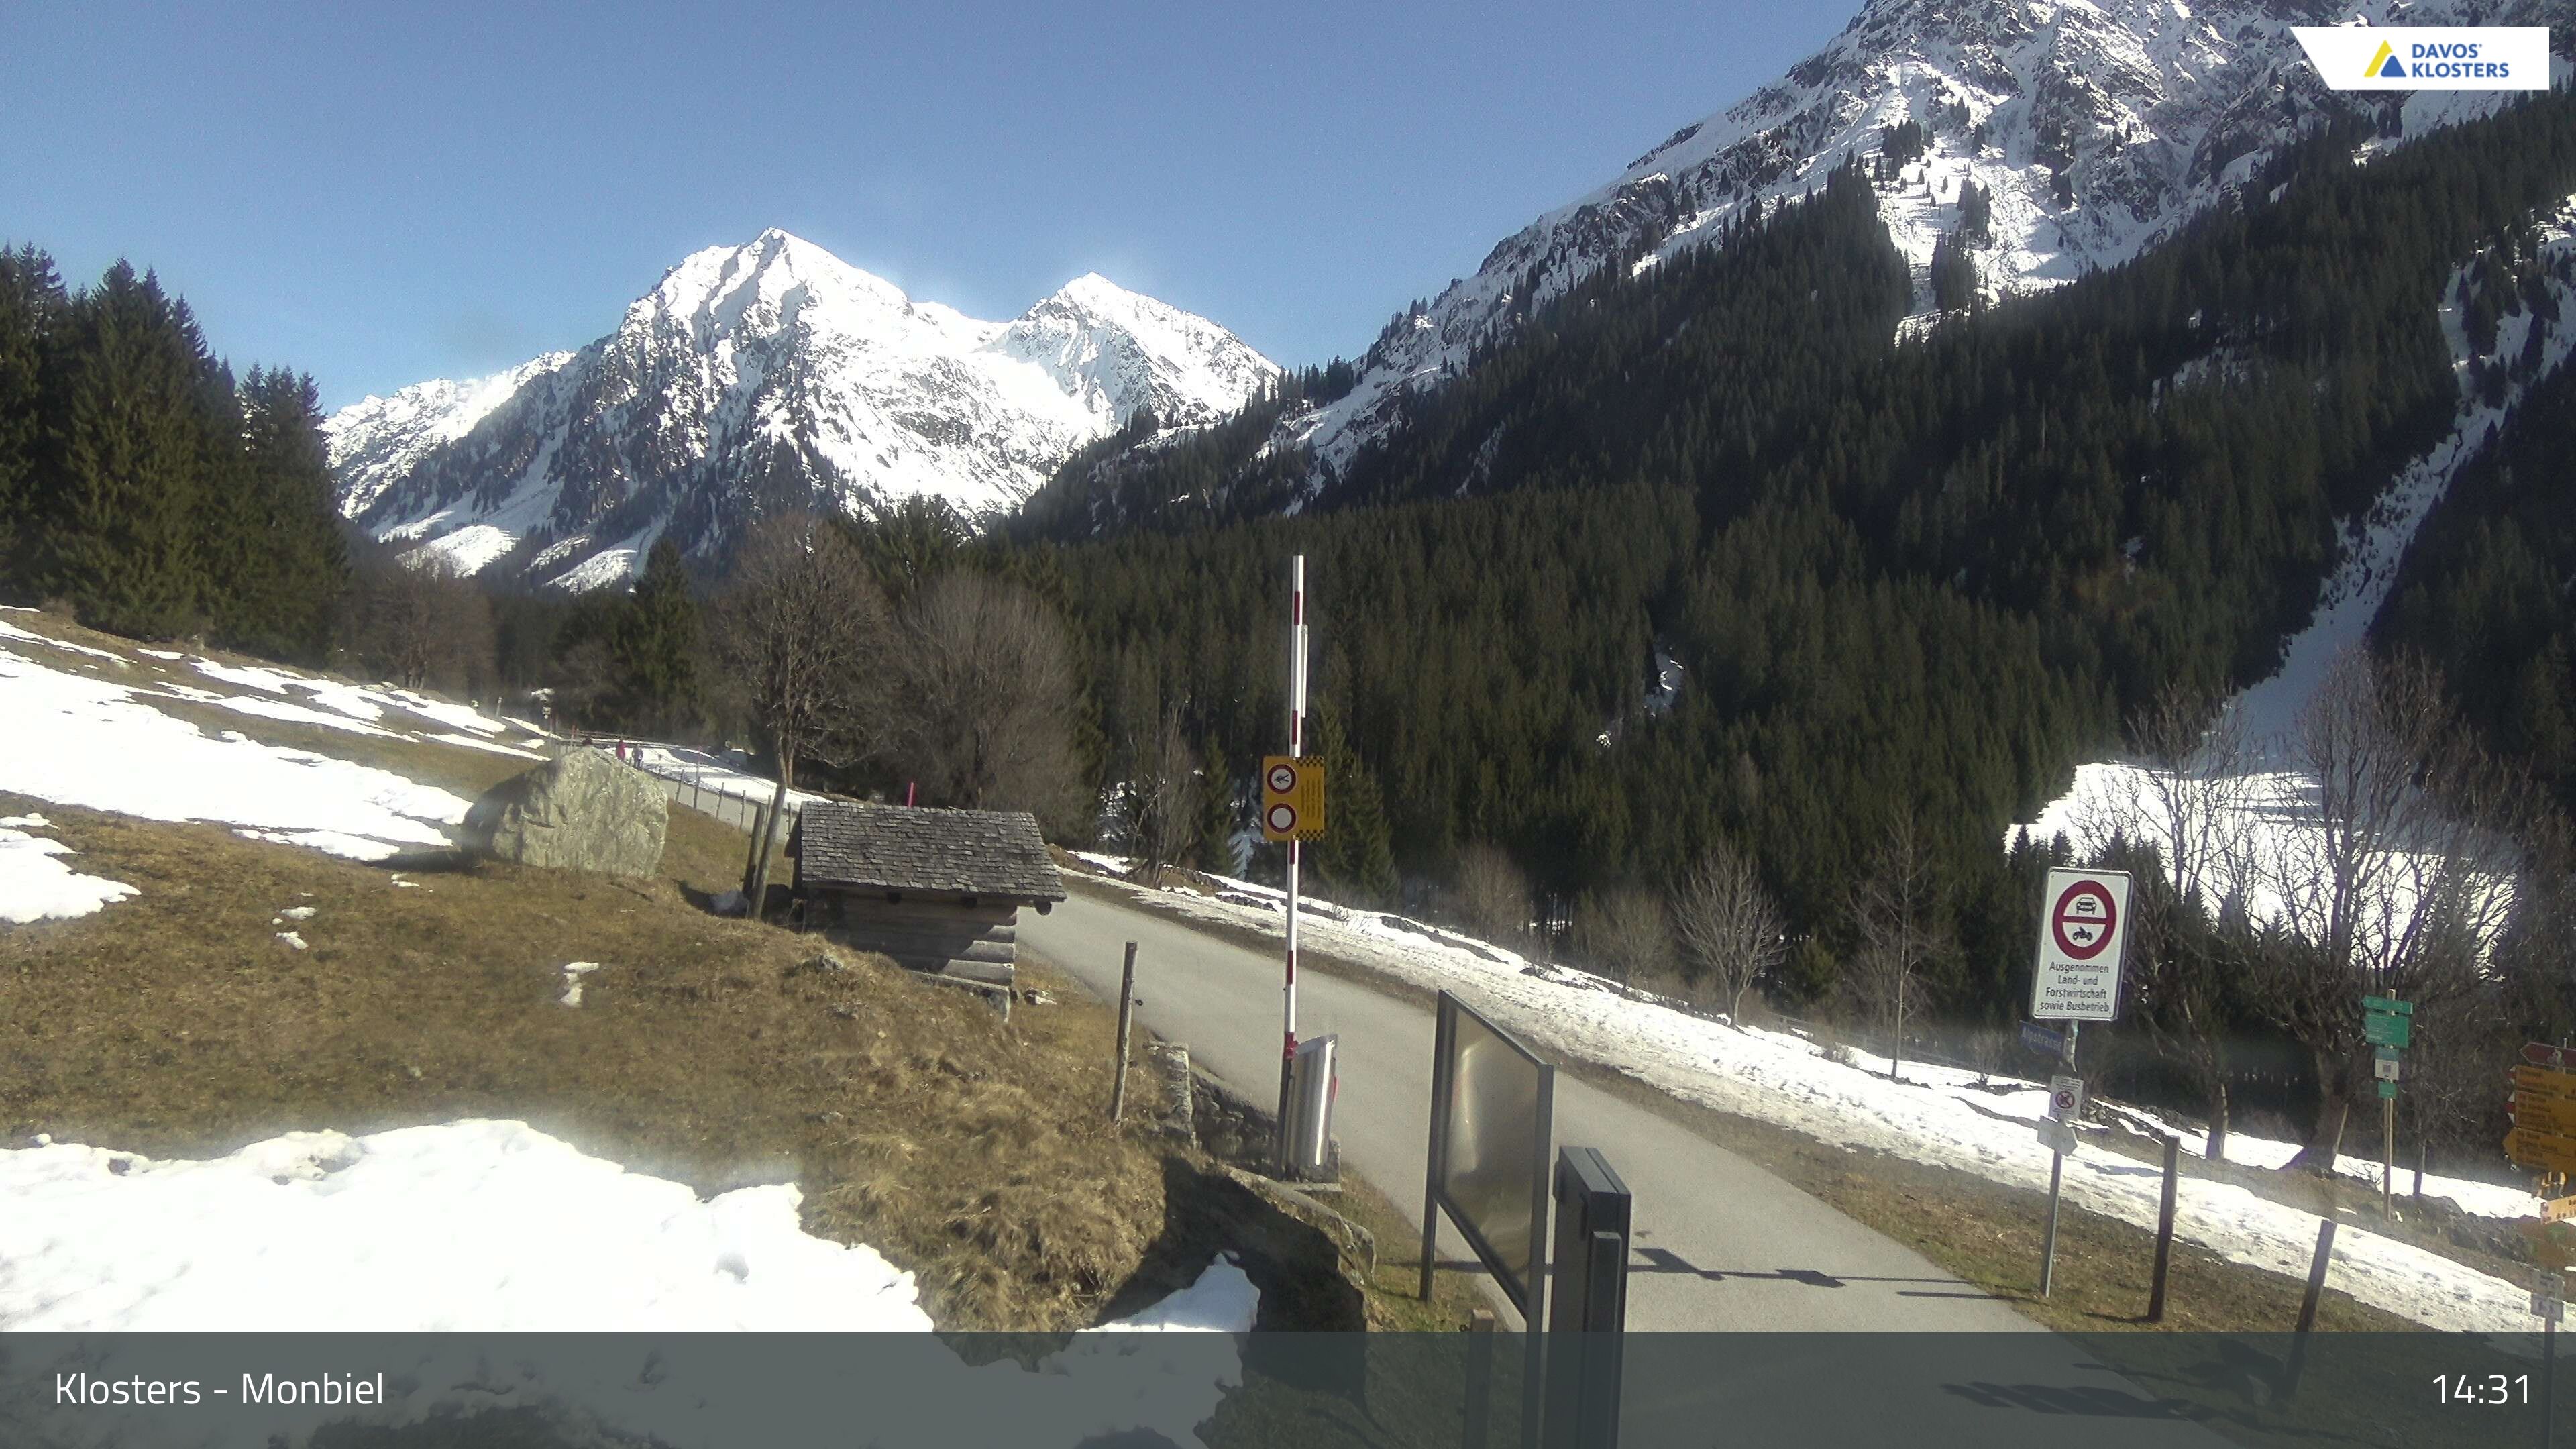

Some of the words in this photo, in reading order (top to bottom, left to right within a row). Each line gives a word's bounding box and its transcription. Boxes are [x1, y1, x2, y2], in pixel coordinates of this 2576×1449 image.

[2049, 961, 2109, 974] Ausgenommen
[2057, 975, 2081, 985] Land-
[2082, 975, 2098, 985] und
[2045, 987, 2107, 999] Forstwirtschaft
[2040, 1000, 2065, 1010] sowie
[2066, 1000, 2110, 1012] Busbetrieb
